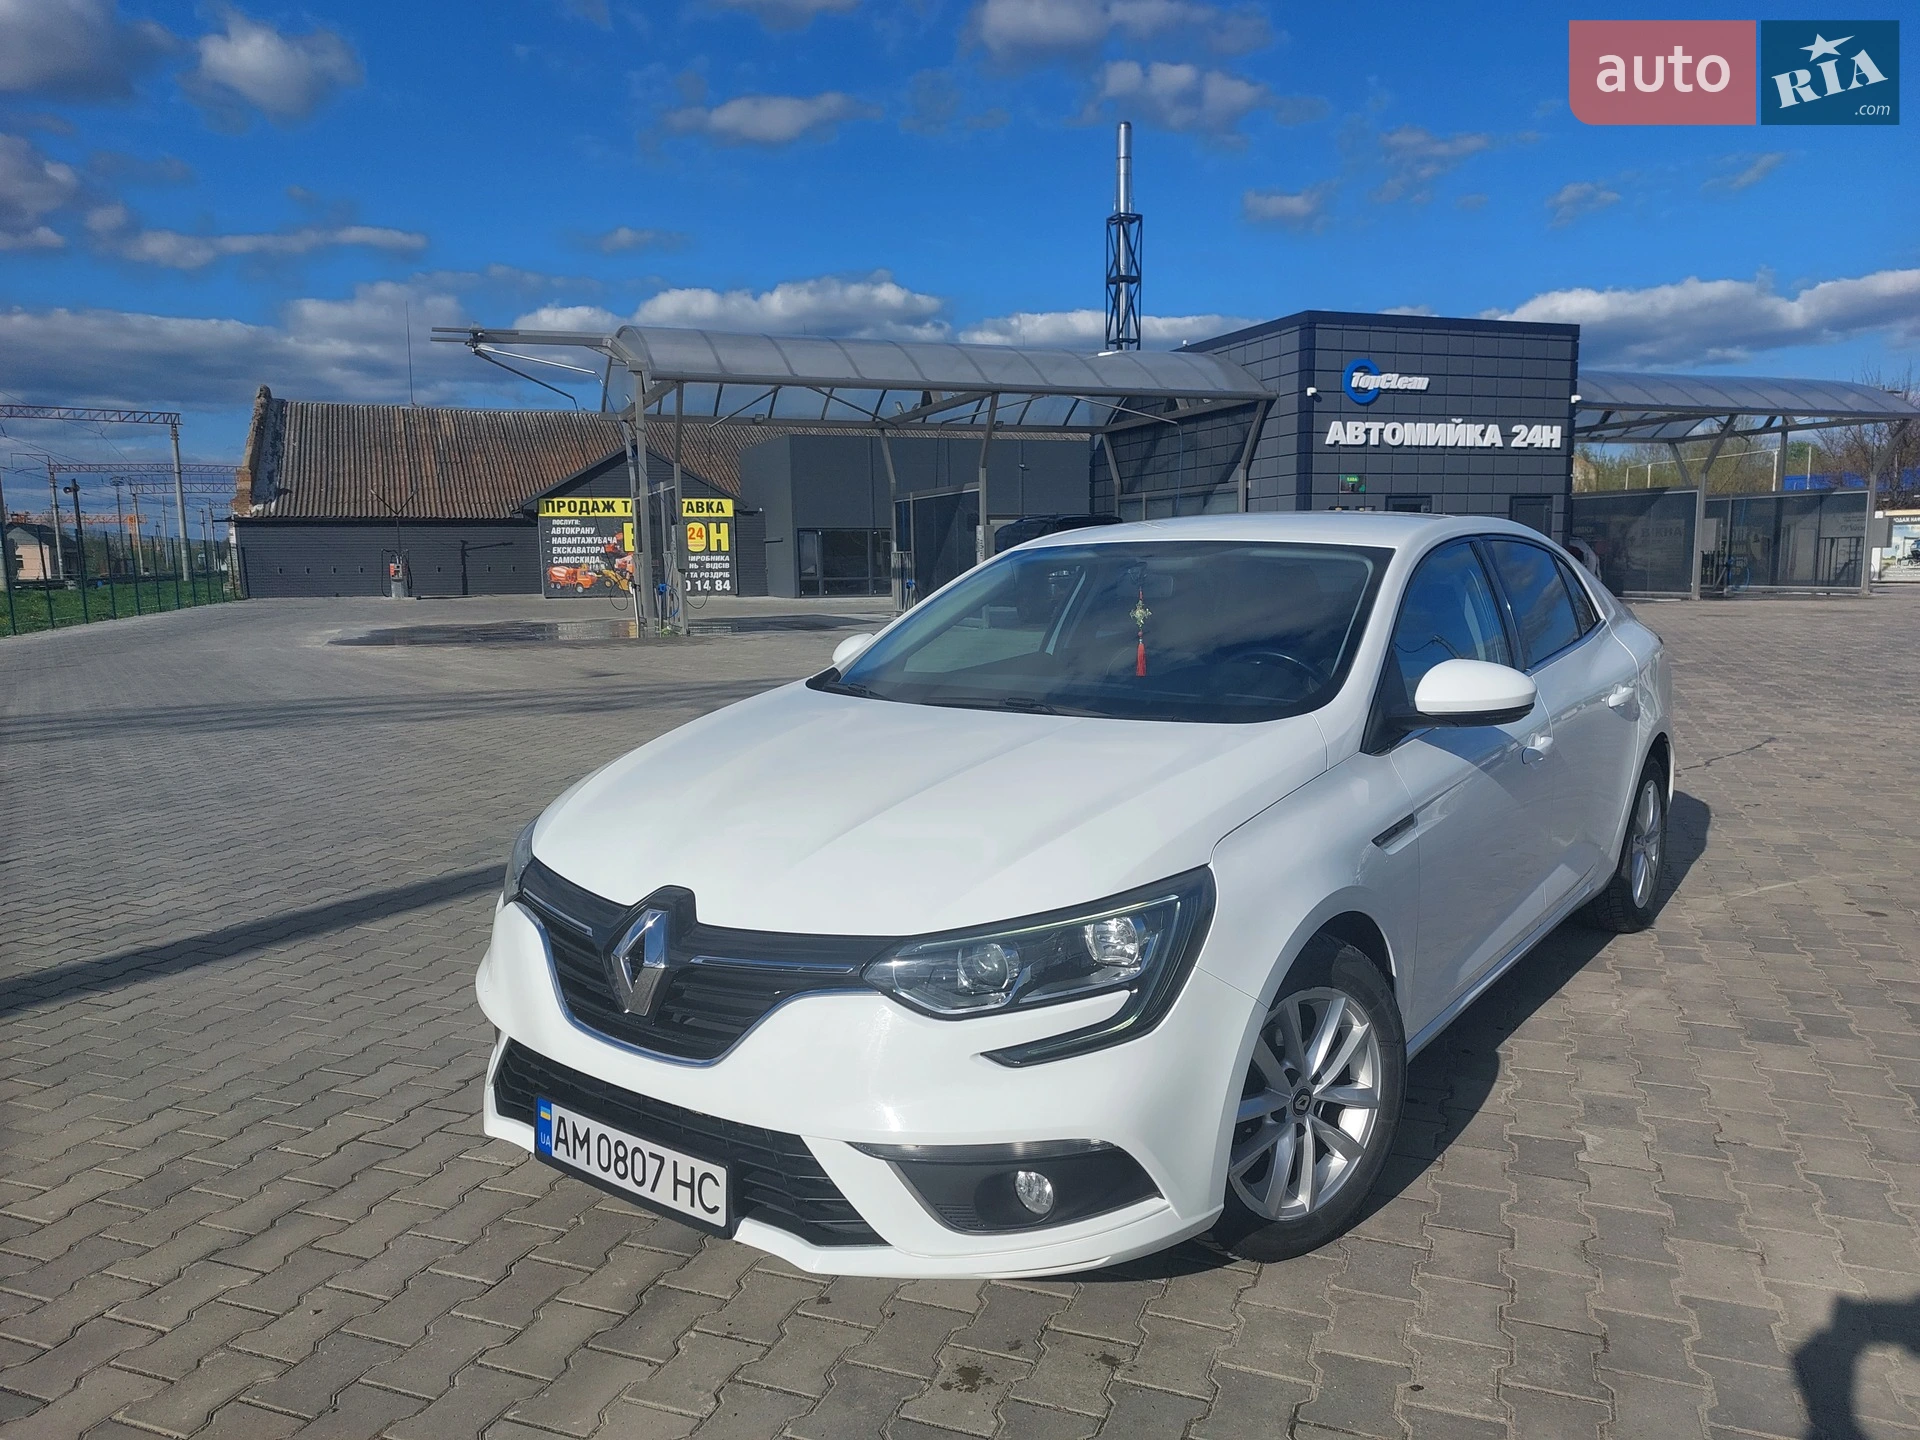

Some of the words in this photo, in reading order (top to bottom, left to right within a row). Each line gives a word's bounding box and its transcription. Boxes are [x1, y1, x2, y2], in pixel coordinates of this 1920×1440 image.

[1325, 418, 1503, 448] АВТОМИЙКА
[545, 500, 616, 516] ПРОДАЖ
[551, 527, 595, 535] АВТОКРАНУ
[688, 527, 705, 541] 24
[551, 536, 618, 545] НАВАНТАЖУВАЧА
[552, 546, 606, 555] ЕКСКАВАТОРА
[552, 555, 600, 565] САМОСКИДА
[695, 580, 712, 591] 14
[715, 580, 731, 591] 84
[540, 1131, 551, 1148] UA
[554, 1115, 591, 1166] AM
[597, 1133, 666, 1193] 0807
[672, 1160, 721, 1215] HC
